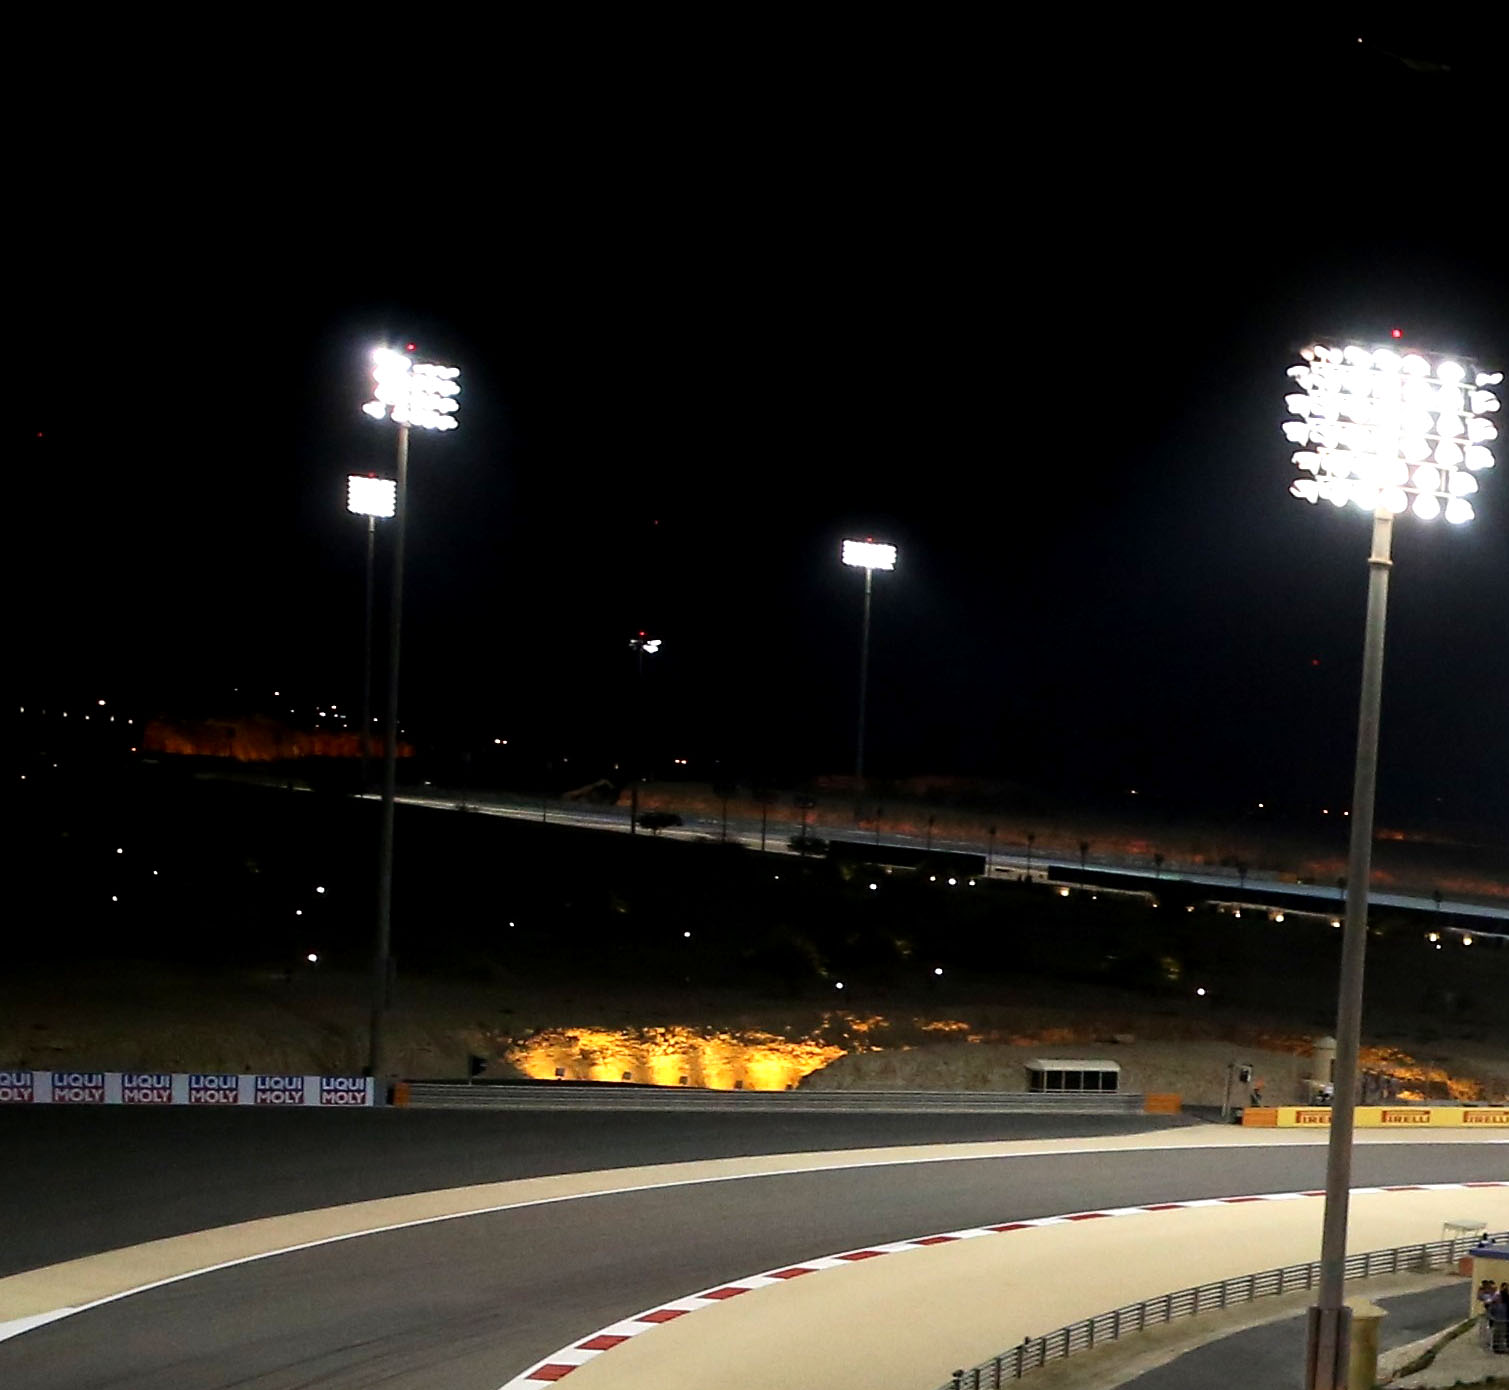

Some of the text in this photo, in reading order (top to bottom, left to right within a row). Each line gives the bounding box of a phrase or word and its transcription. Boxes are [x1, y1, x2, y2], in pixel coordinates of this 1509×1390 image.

[54, 1074, 103, 1087] LIQUI
[124, 1075, 170, 1087] LIQUI
[191, 1076, 236, 1089] LIQUI
[257, 1076, 302, 1089] LIQUI
[322, 1077, 364, 1090] LIQUI
[54, 1089, 104, 1100] MOLY
[124, 1089, 171, 1101] MOLY
[191, 1090, 237, 1102] MOLY
[257, 1091, 303, 1103] MOLY
[322, 1092, 365, 1104] MOLY
[1296, 1110, 1332, 1124] PIRE
[1381, 1110, 1431, 1124] PIRELLI
